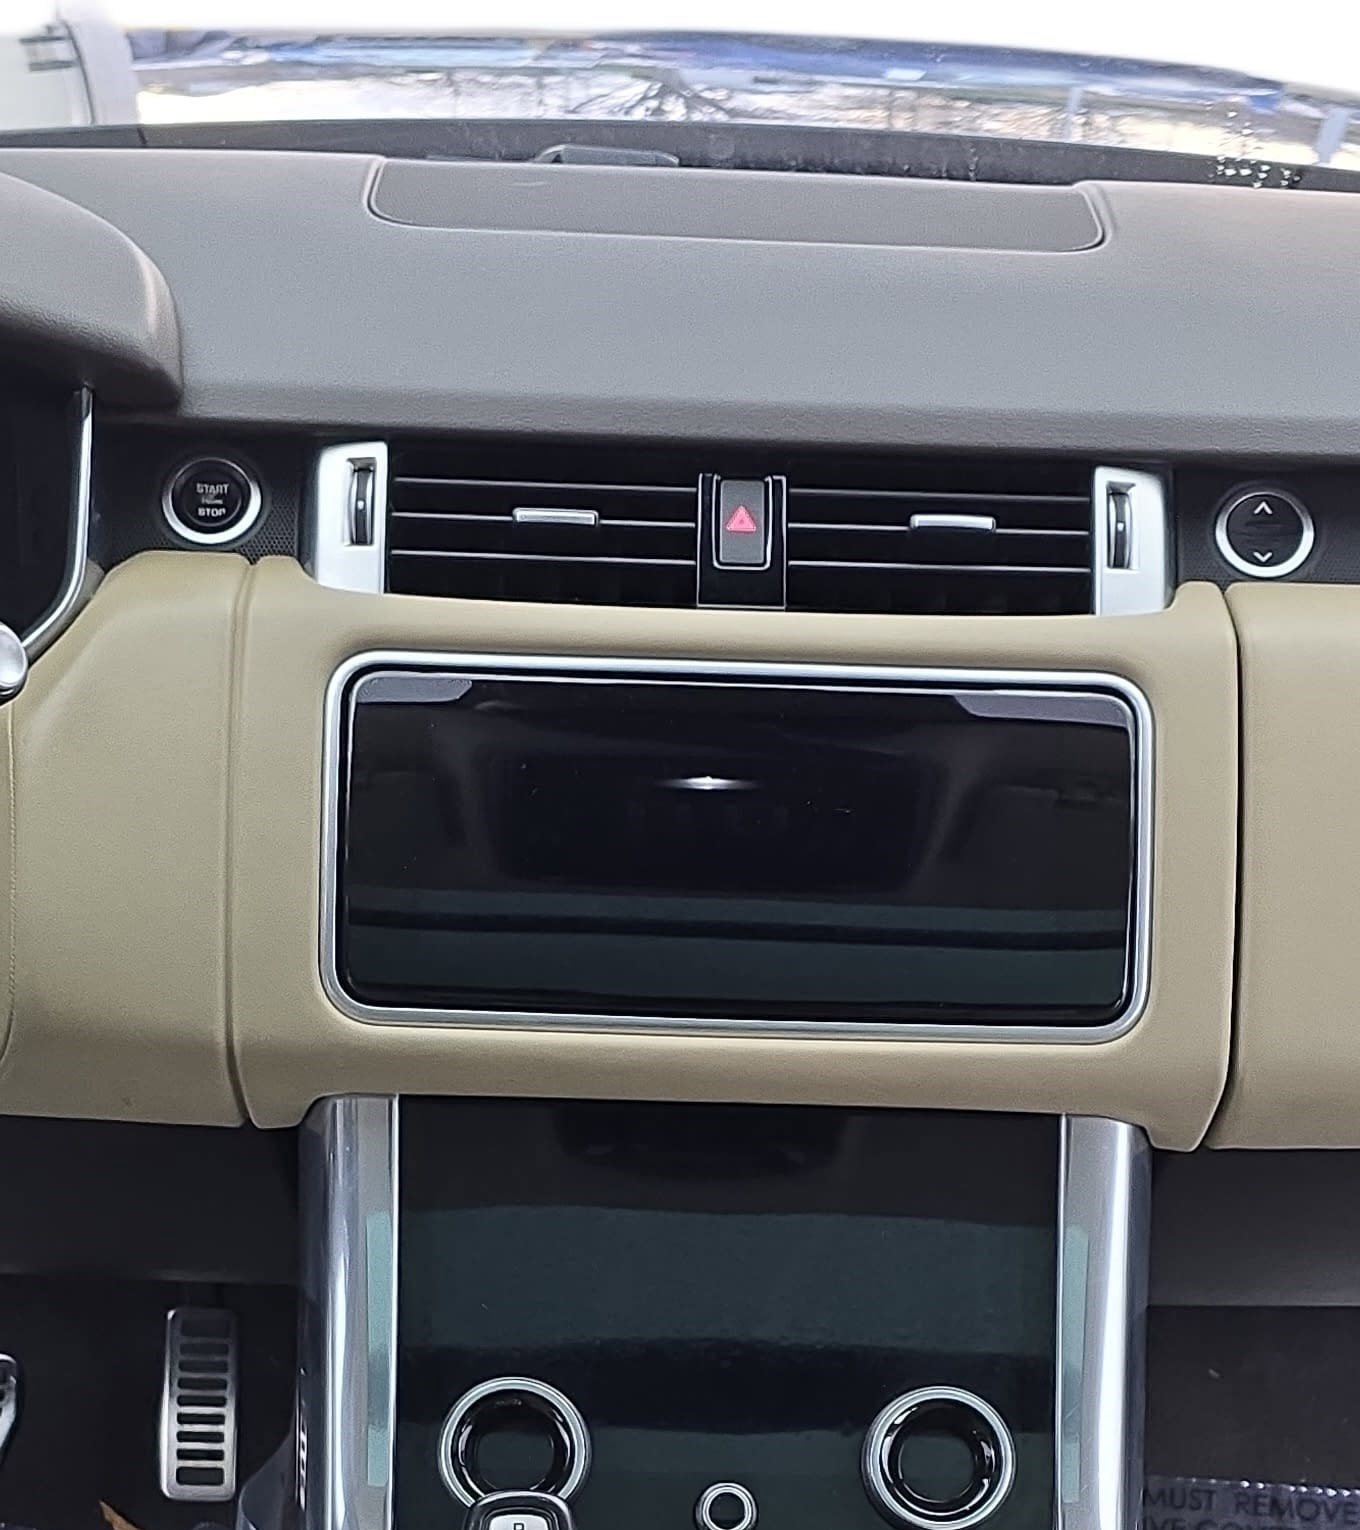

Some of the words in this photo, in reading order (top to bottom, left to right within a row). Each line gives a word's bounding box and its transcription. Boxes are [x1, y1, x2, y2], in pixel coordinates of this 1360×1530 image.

[196, 483, 229, 494] START
[198, 507, 226, 517] STOP
[1234, 1492, 1359, 1526] REMOVE
